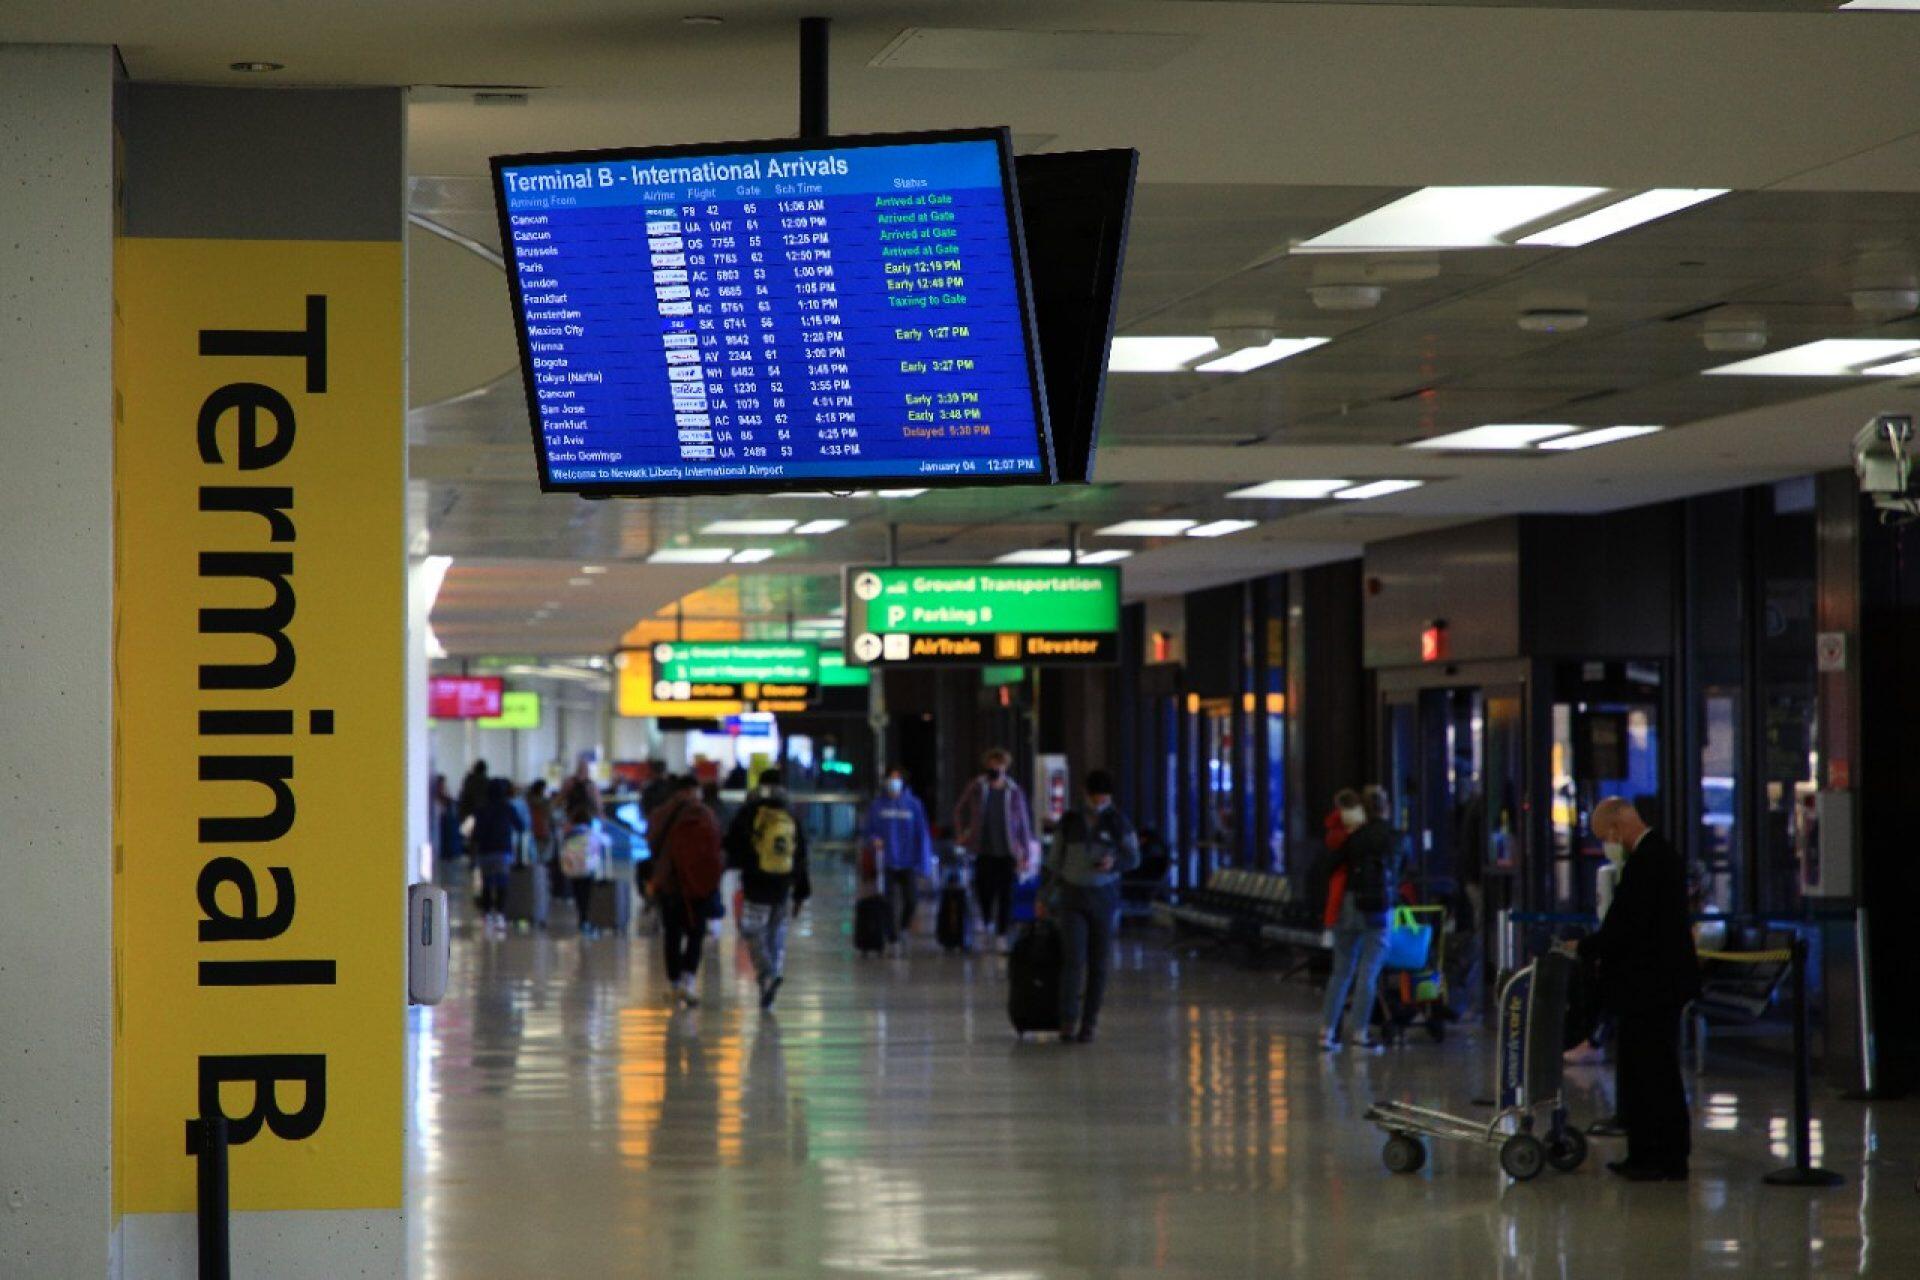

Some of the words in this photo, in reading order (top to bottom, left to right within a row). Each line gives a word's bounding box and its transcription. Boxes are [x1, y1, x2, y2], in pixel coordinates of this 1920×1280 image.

[504, 168, 592, 192] Terminal
[598, 167, 614, 186] B
[631, 159, 761, 185] International
[767, 155, 848, 178] Arrivals
[687, 188, 716, 201] Flight
[736, 185, 760, 195] Gate
[775, 184, 795, 194] Sch
[797, 182, 822, 193] Time
[893, 178, 927, 188] Status
[510, 215, 548, 225] Cancun
[807, 199, 824, 210] AM
[875, 195, 914, 206] Arrived
[915, 195, 927, 205] at
[927, 193, 952, 204] Gate
[513, 230, 551, 240] Cancun
[685, 222, 701, 233] UA
[809, 216, 826, 227] PM
[878, 212, 916, 223] Arrived
[917, 212, 927, 222] at
[929, 211, 954, 221] Gate
[516, 245, 558, 257] Brussels
[812, 232, 829, 243] PM
[880, 228, 918, 240] Arrived
[920, 228, 930, 238] at
[932, 227, 957, 238] Gate
[518, 262, 543, 272] Paris
[814, 249, 831, 260] PM
[882, 245, 920, 256] Arrived
[922, 245, 933, 255] at
[935, 244, 959, 254] Gate
[520, 278, 558, 288] London
[692, 271, 708, 282] AC
[816, 265, 833, 276] PM
[884, 262, 911, 275] Early
[943, 259, 960, 271] PM
[523, 293, 567, 304] Frankfurt
[695, 287, 710, 297] AC
[795, 281, 817, 294] 1:05
[819, 281, 836, 292] PM
[886, 279, 914, 291] Early
[946, 276, 963, 287] PM
[526, 309, 581, 320] Amsterdam
[821, 298, 838, 309] PM
[888, 296, 927, 308] Taxiing
[928, 295, 939, 305] to
[942, 293, 966, 304] Gate
[527, 325, 562, 336] Mexico
[563, 324, 584, 336] City
[823, 314, 840, 324] PM
[530, 341, 564, 352] Vienna
[702, 335, 717, 346] UA
[826, 331, 843, 342] PM
[895, 328, 922, 340] Early
[928, 326, 949, 338] 1:27
[952, 326, 969, 336] PM
[533, 357, 568, 369] Bogota
[828, 346, 845, 358] PM
[535, 372, 565, 385] Tokyo
[568, 371, 602, 384] (Narita)
[830, 363, 848, 374] PM
[900, 361, 926, 373] Early
[932, 359, 953, 371] 3:27
[956, 359, 974, 370] PM
[537, 389, 575, 399] Cancun
[734, 382, 756, 393] 1230
[770, 382, 783, 392] 52
[833, 379, 851, 390] PM
[541, 404, 560, 414] San
[561, 403, 585, 414] Jose
[712, 399, 728, 409] UA
[836, 395, 853, 406] PM
[905, 393, 932, 406] Early
[961, 392, 978, 403] PM
[543, 419, 588, 430] Frankfurt
[714, 415, 729, 426] AC
[838, 412, 855, 422] PM
[908, 409, 934, 422] Early
[963, 408, 981, 419] PM
[545, 434, 561, 445] Tel
[563, 434, 584, 445] Aviv
[716, 431, 732, 442] UA
[840, 428, 858, 438] PM
[902, 427, 944, 438] Delayed
[973, 425, 990, 434] PM
[548, 451, 576, 461] Santo
[578, 450, 622, 462] Domingo
[719, 446, 735, 458] UA
[843, 443, 861, 454] PM
[552, 469, 596, 479] Welcome
[598, 469, 609, 478] to
[611, 468, 648, 478] Newark
[649, 467, 682, 479] Liberty
[685, 465, 746, 476] International
[748, 464, 783, 475] Airport
[919, 461, 960, 473] January
[1017, 459, 1035, 469] PM
[913, 576, 976, 592] Ground
[980, 576, 1102, 595] Transportation
[912, 607, 977, 626] Parking
[197, 294, 336, 985] Terminal
[912, 637, 981, 655] AirTrain
[1027, 637, 1098, 654] Elevator
[198, 1055, 326, 1145] B
